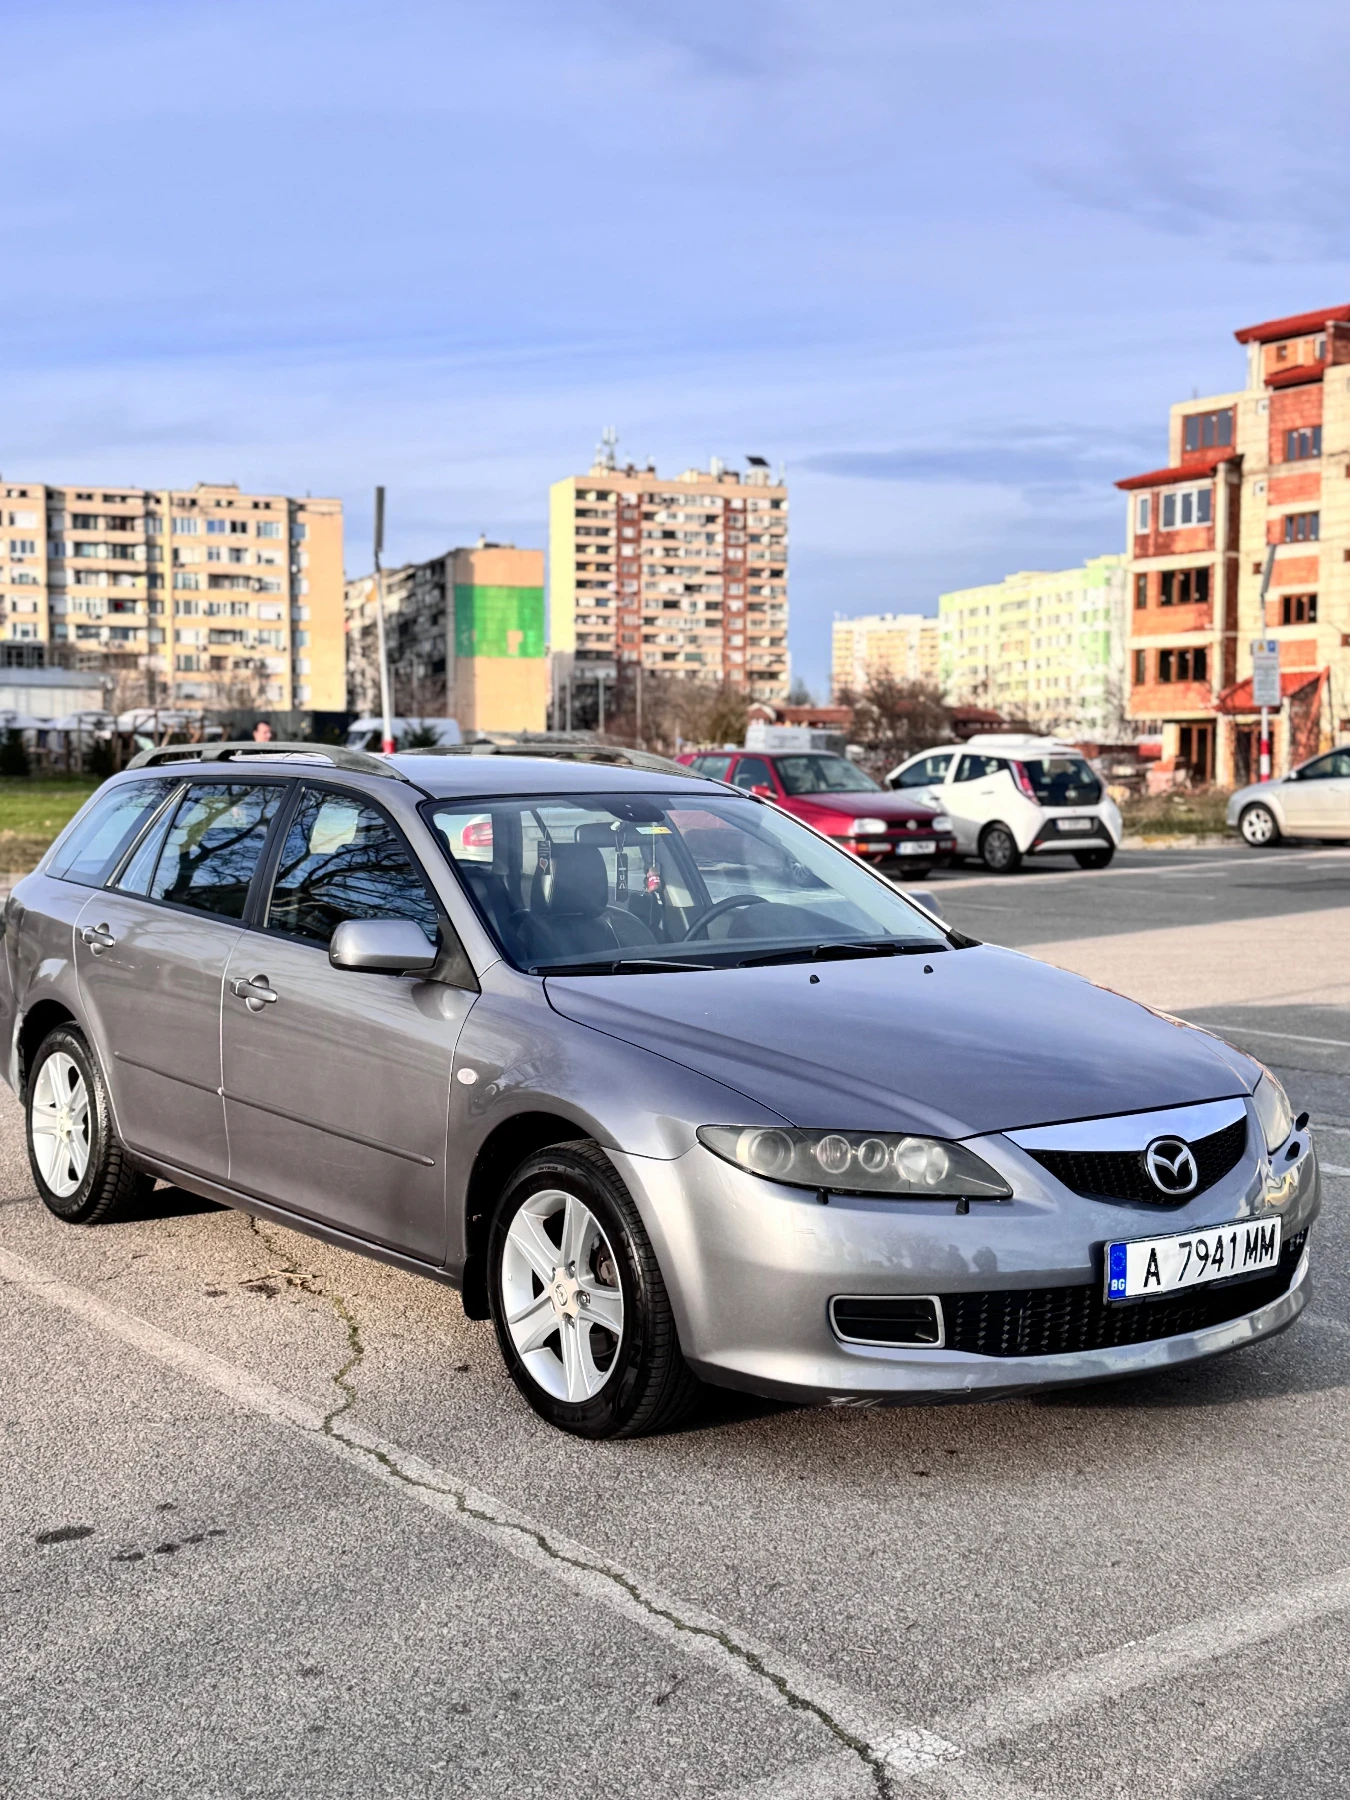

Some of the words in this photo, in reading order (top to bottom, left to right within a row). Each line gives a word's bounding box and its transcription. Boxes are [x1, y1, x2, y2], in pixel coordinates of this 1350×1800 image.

[1143, 1248, 1161, 1288] A
[1178, 1231, 1237, 1282] 7941
[1243, 1223, 1276, 1267] MM
[1111, 1278, 1126, 1291] BG
